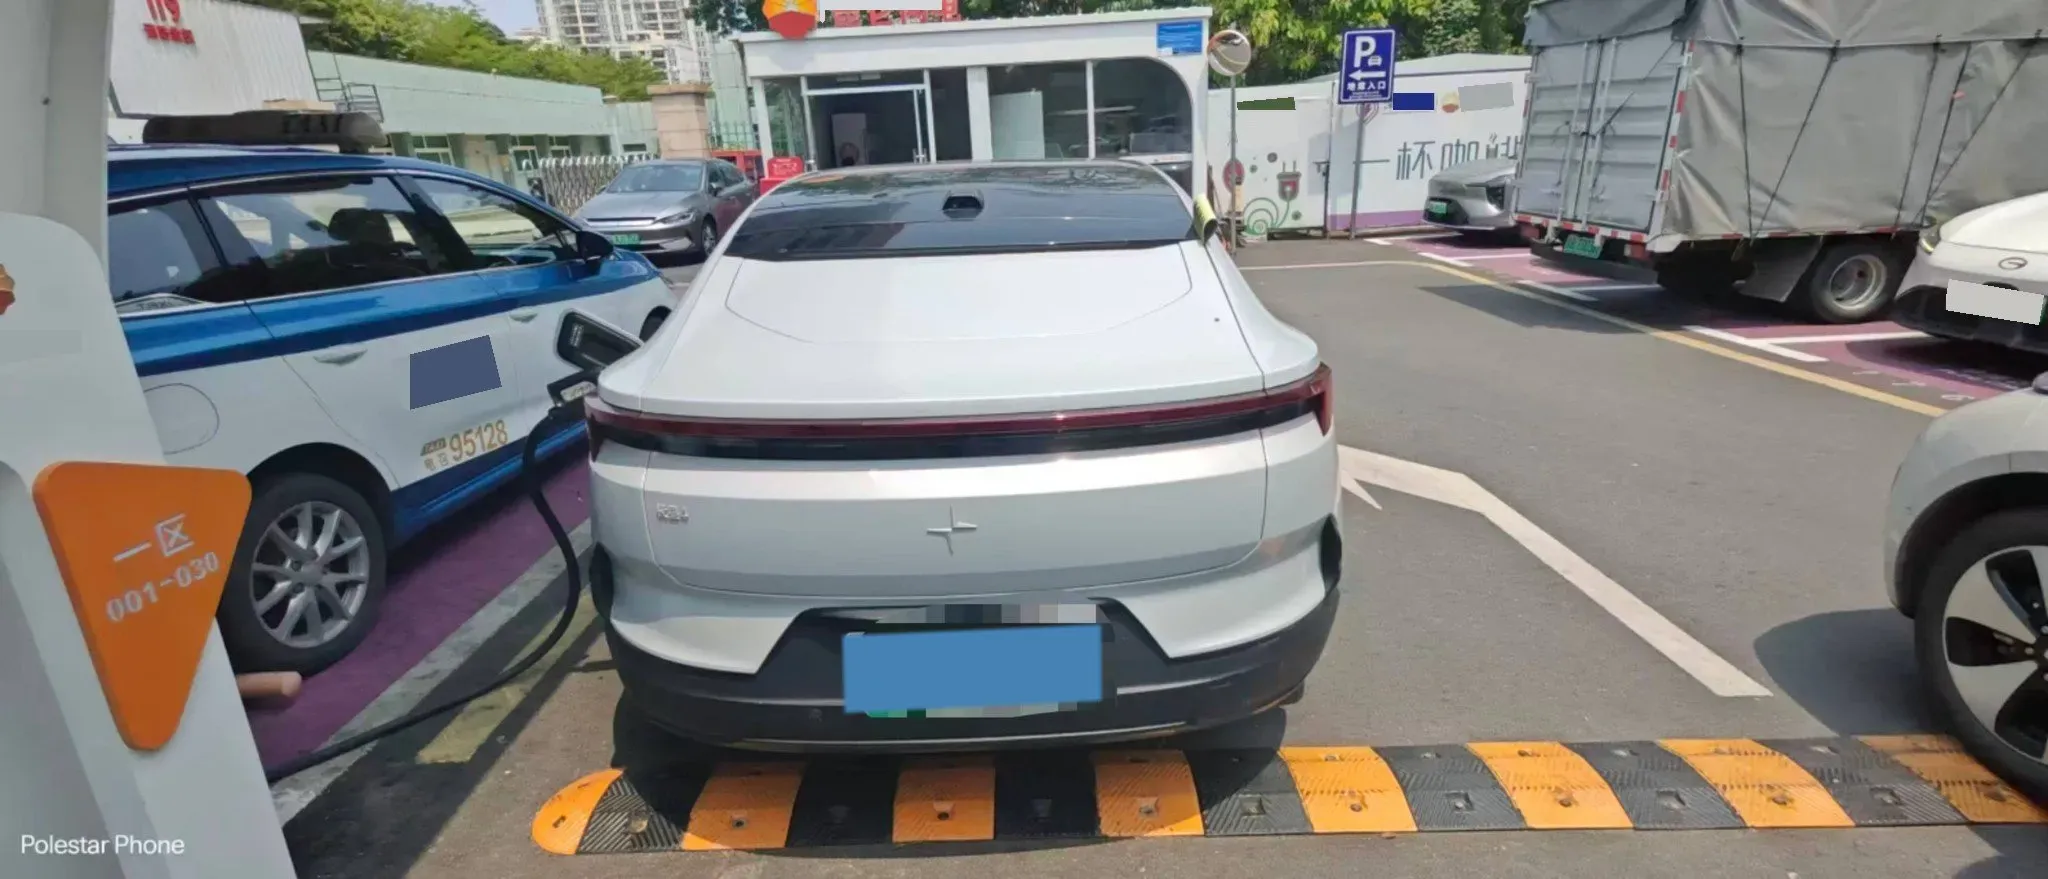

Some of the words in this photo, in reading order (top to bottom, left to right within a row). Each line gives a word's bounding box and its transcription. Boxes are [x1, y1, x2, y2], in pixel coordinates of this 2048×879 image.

[1354, 36, 1376, 68] P
[449, 419, 508, 461] 95128
[112, 513, 194, 562] 一区
[105, 551, 219, 623] 001-030
